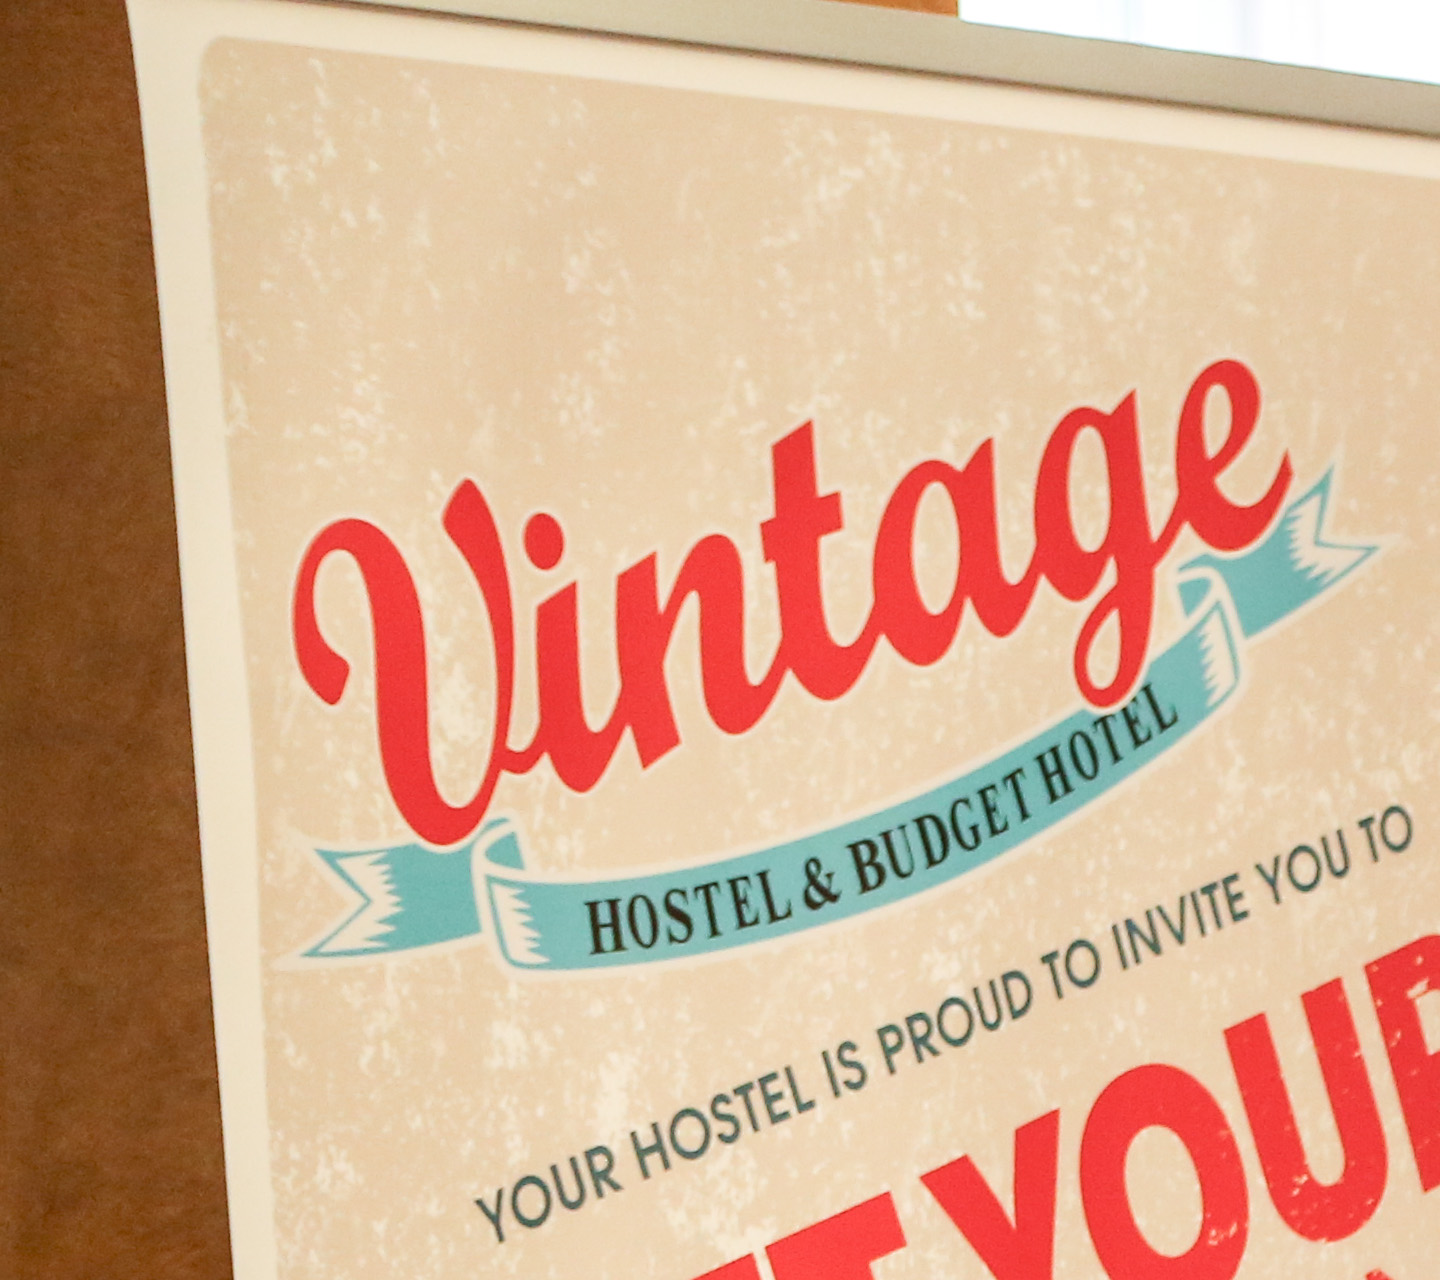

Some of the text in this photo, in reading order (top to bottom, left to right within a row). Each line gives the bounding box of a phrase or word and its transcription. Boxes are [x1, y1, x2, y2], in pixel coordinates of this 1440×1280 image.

[293, 357, 1293, 845] Vintage
[584, 683, 1178, 955] HOSTEL & BUDGET HOTEL
[475, 805, 1413, 1243] YOUR HOSTEL IS PROUD TO INVITE YOU TO
